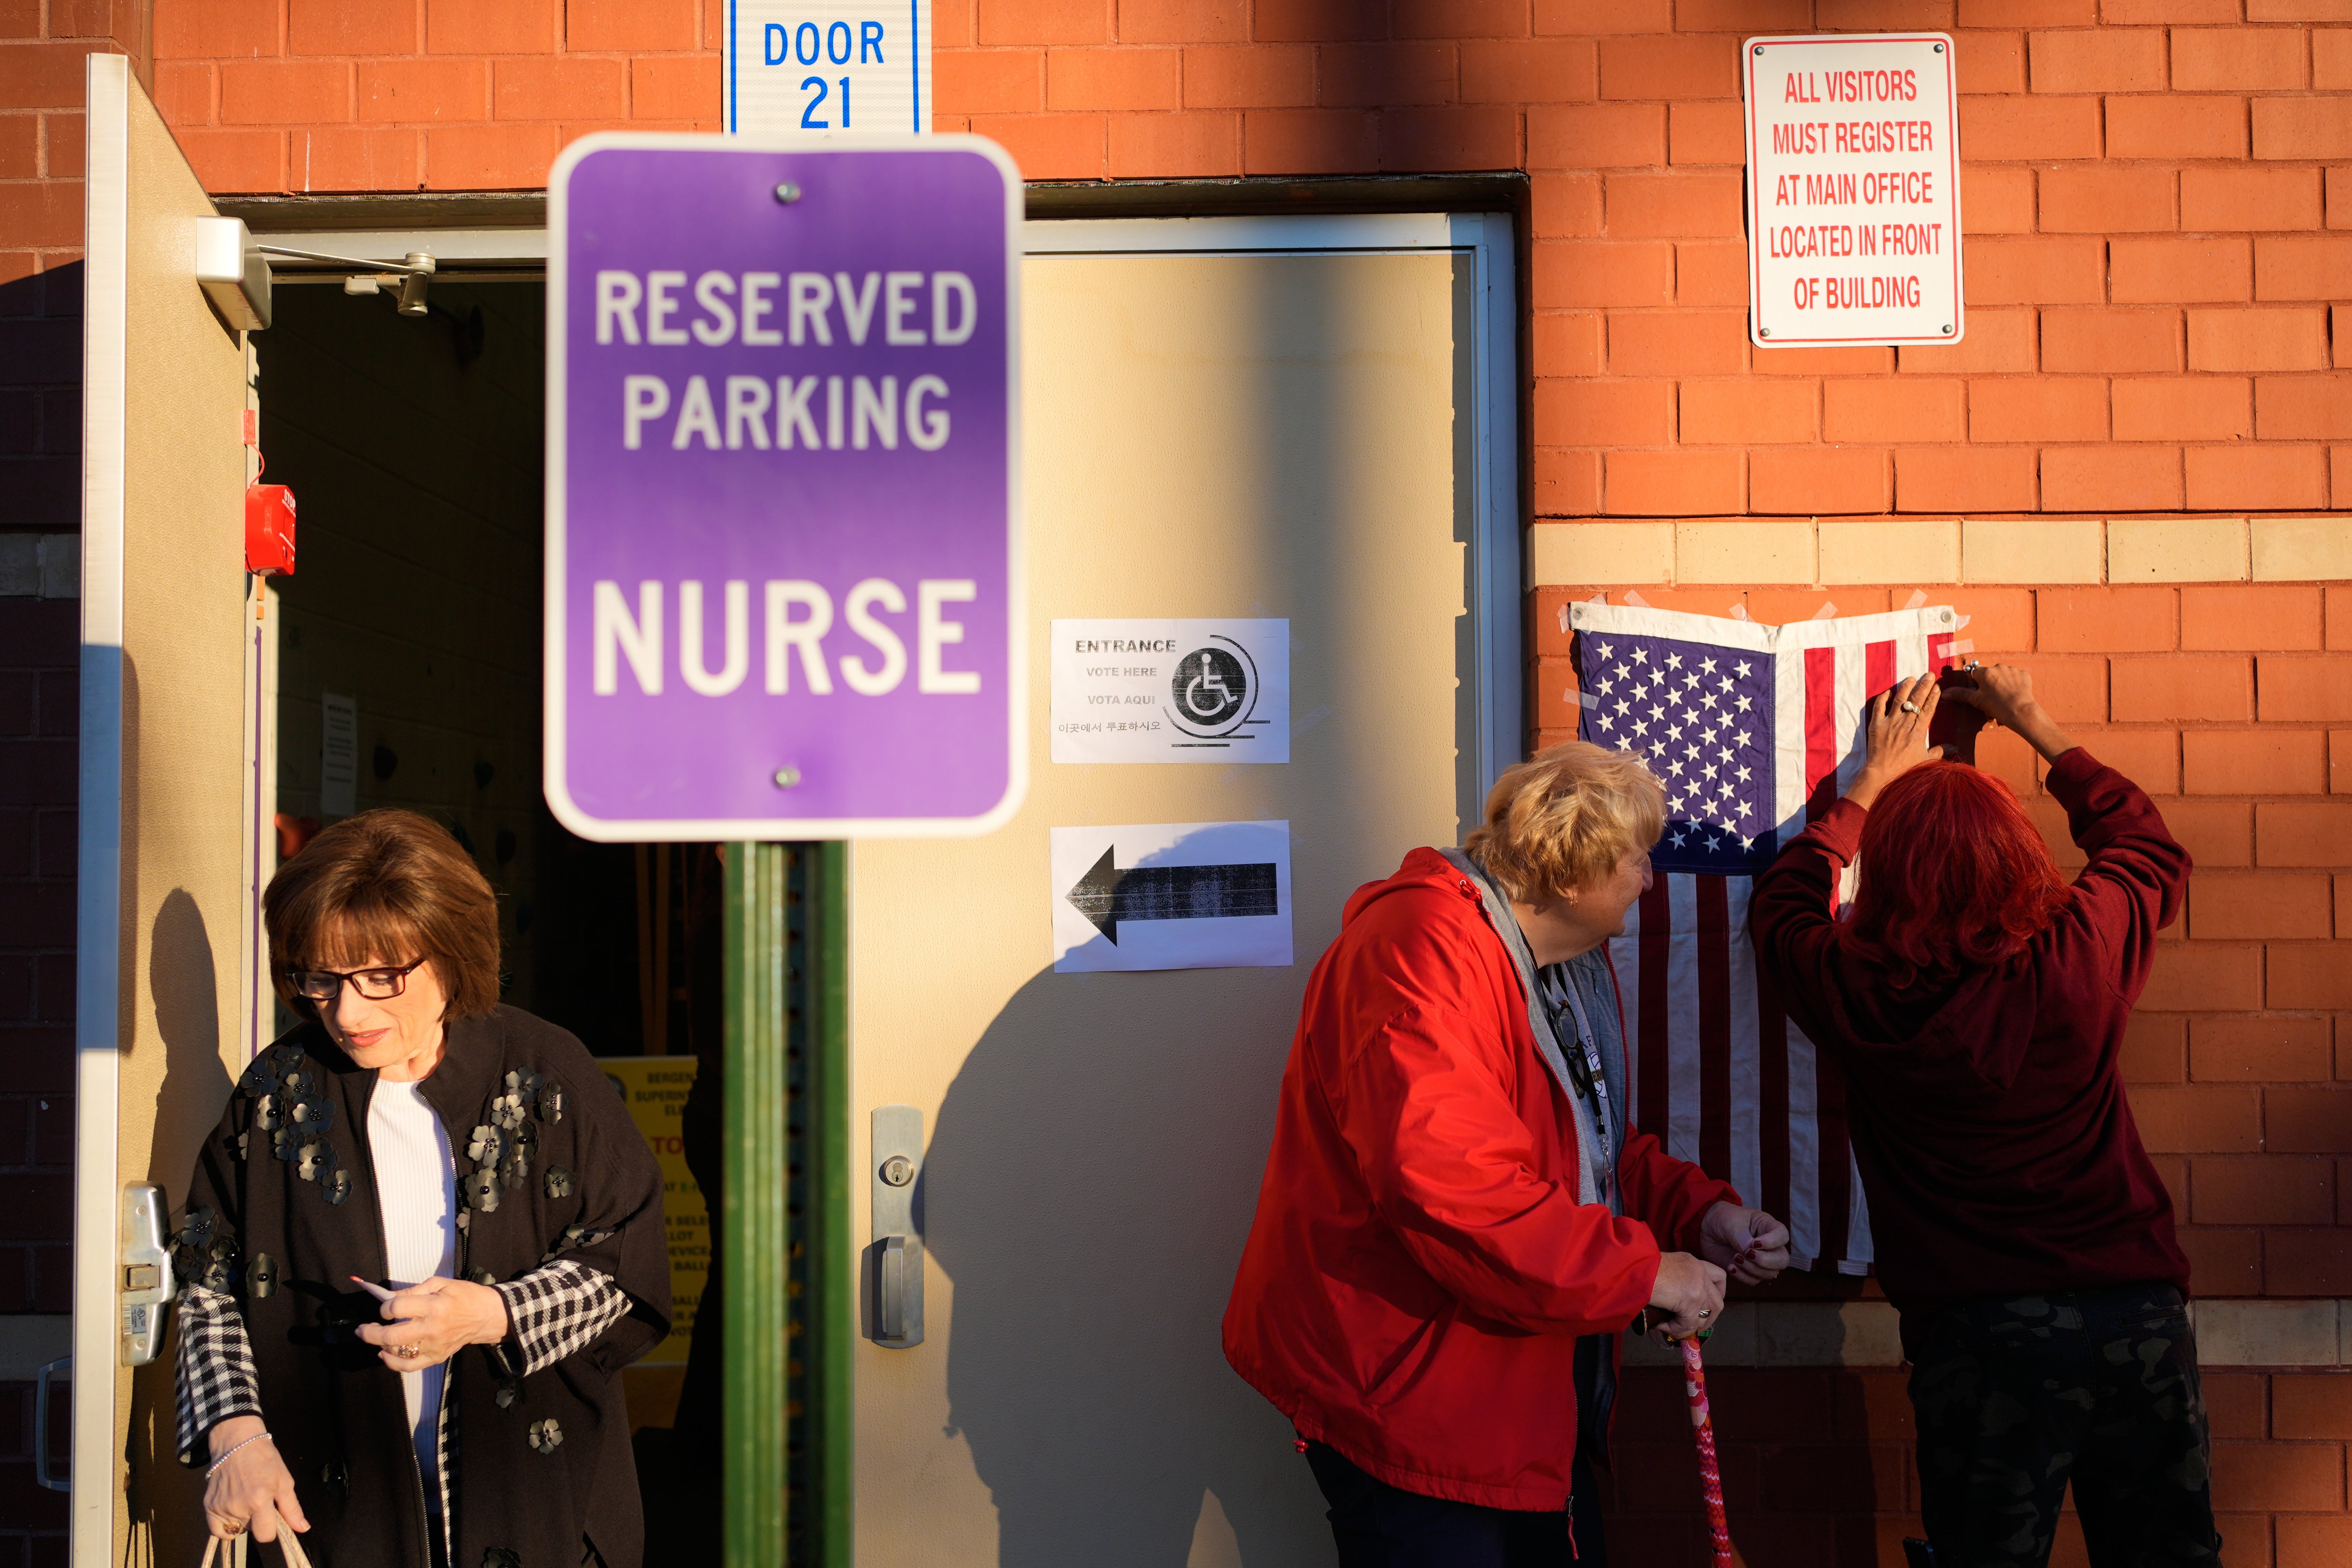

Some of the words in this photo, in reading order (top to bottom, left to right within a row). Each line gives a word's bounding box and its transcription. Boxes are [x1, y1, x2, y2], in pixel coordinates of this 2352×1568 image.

[765, 21, 884, 65] DOOR
[800, 76, 850, 129] 21
[1785, 72, 1821, 103] ALL
[1825, 69, 1917, 102] VISITORS
[1773, 122, 1829, 154] MUST
[1836, 121, 1933, 153] REGISTER
[1776, 174, 1800, 206] AT
[1806, 174, 1857, 205] MAIN
[1863, 172, 1933, 204] OFFICE
[1770, 225, 1853, 258] LOCATED
[1859, 225, 1876, 256] IN
[1882, 223, 1942, 256] FRONT
[595, 270, 978, 347] RESERVED
[1794, 278, 1819, 310] OF
[1826, 276, 1920, 309] BUILDING
[624, 374, 951, 452] PARKING
[593, 577, 982, 698] NURSE
[1075, 639, 1176, 653] ENTRANCE
[1086, 667, 1119, 677] VOTE
[1123, 667, 1157, 677] HERE
[1087, 695, 1120, 704] VOTA
[1124, 695, 1155, 705] AQUI
[1058, 722, 1102, 733] 이곳에서
[1106, 721, 1161, 732] 투표하시오
